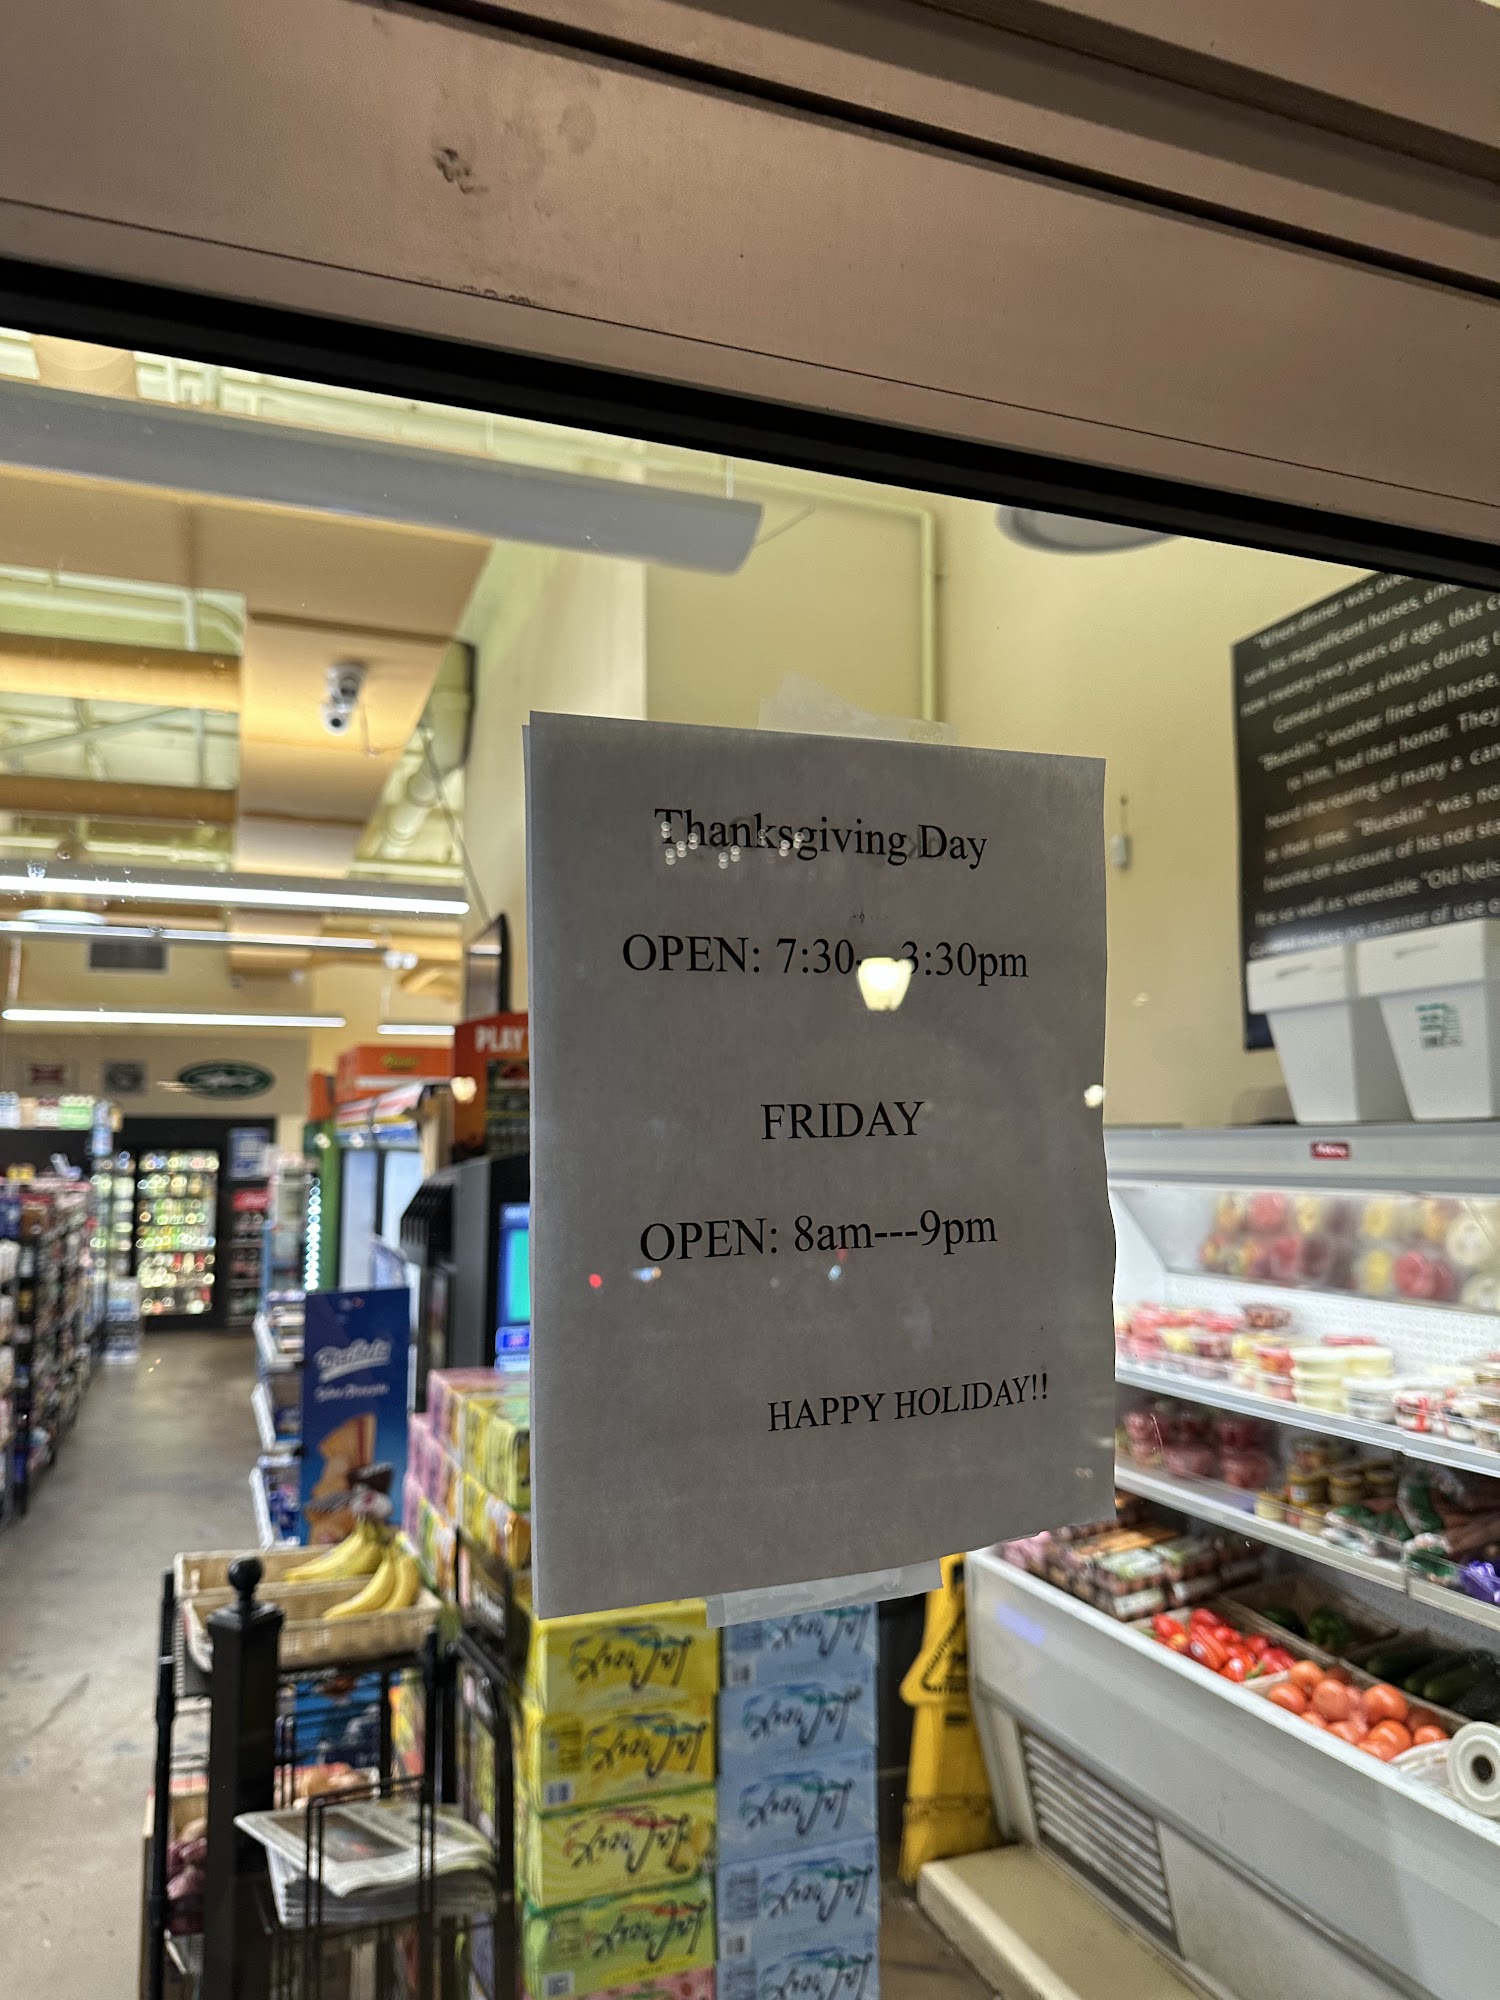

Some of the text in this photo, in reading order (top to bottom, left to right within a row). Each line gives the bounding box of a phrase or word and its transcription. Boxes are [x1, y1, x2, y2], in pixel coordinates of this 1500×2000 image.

[1346, 642, 1389, 676] years
[1389, 630, 1408, 653] of
[1448, 600, 1484, 628] that
[1325, 681, 1376, 713] almost
[1377, 659, 1432, 692] always
[1433, 634, 1491, 669] during
[1385, 702, 1418, 724] fine
[1417, 686, 1446, 712] old
[1335, 751, 1366, 775] had
[1365, 741, 1398, 765] that
[1457, 704, 1500, 733] They
[1381, 770, 1400, 793] of
[1401, 760, 1448, 788] many
[1450, 755, 1465, 772] a
[1436, 791, 1474, 814] was
[654, 808, 987, 870] Thanksgiving Day
[1311, 862, 1333, 881] on
[1333, 846, 1395, 875] account
[1395, 836, 1416, 859] of
[1416, 831, 1442, 854] his
[1443, 824, 1474, 848] not
[1296, 895, 1326, 919] well
[1325, 896, 1346, 913] as
[1345, 876, 1421, 907] venerable
[1430, 901, 1453, 925] of
[1453, 898, 1487, 922] use
[622, 934, 760, 972] OPEN:
[475, 1025, 524, 1051] PLAY
[760, 1101, 925, 1140] FRIDAY
[639, 1210, 998, 1262] OPEN: 8am---9pm
[767, 1372, 1048, 1431] HAPPY HOLIDAY!!
